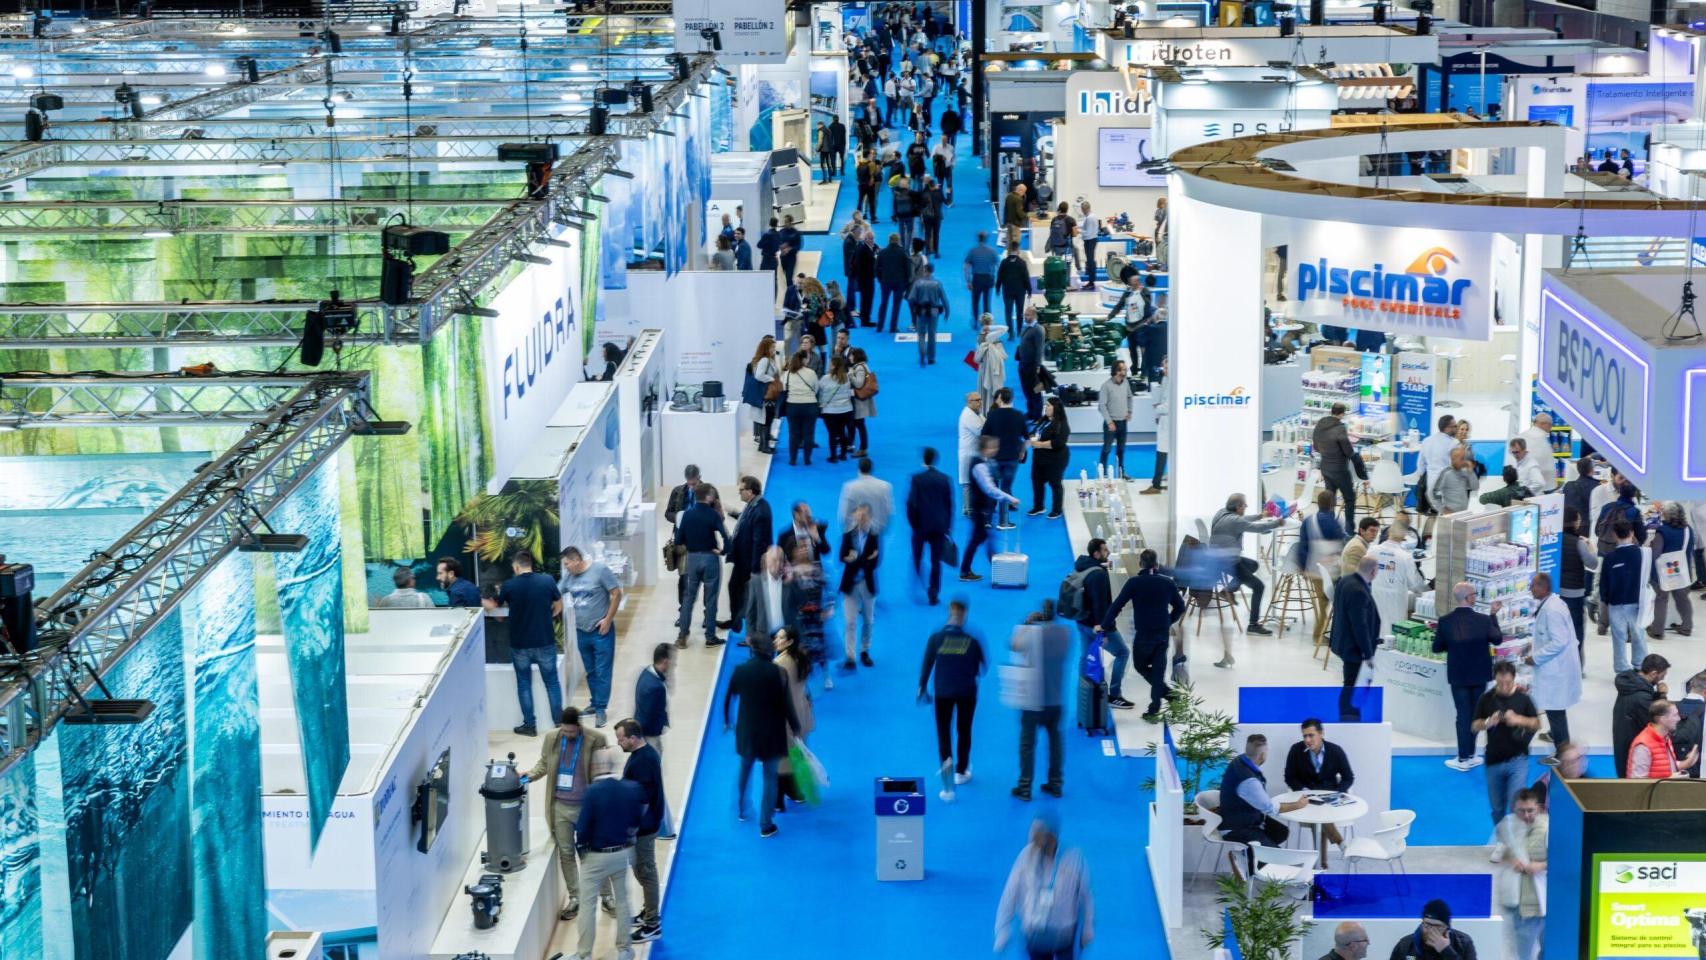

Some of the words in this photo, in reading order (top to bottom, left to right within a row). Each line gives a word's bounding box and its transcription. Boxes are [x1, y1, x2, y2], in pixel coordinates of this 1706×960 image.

[720, 22, 725, 31] 2
[734, 19, 768, 30] PABELLÓN
[769, 21, 775, 30] 2
[1598, 90, 1644, 98] Tratamiento
[1297, 257, 1471, 306] piscimar
[1342, 297, 1376, 311] POOL
[1379, 301, 1461, 320] CHEMICALS
[503, 285, 576, 420] FLUIDRA
[1400, 382, 1429, 393] STARS
[1580, 336, 1626, 435] POOL
[1184, 393, 1251, 409] piscimar
[1637, 862, 1677, 880] saci
[1611, 911, 1681, 929] Optima
